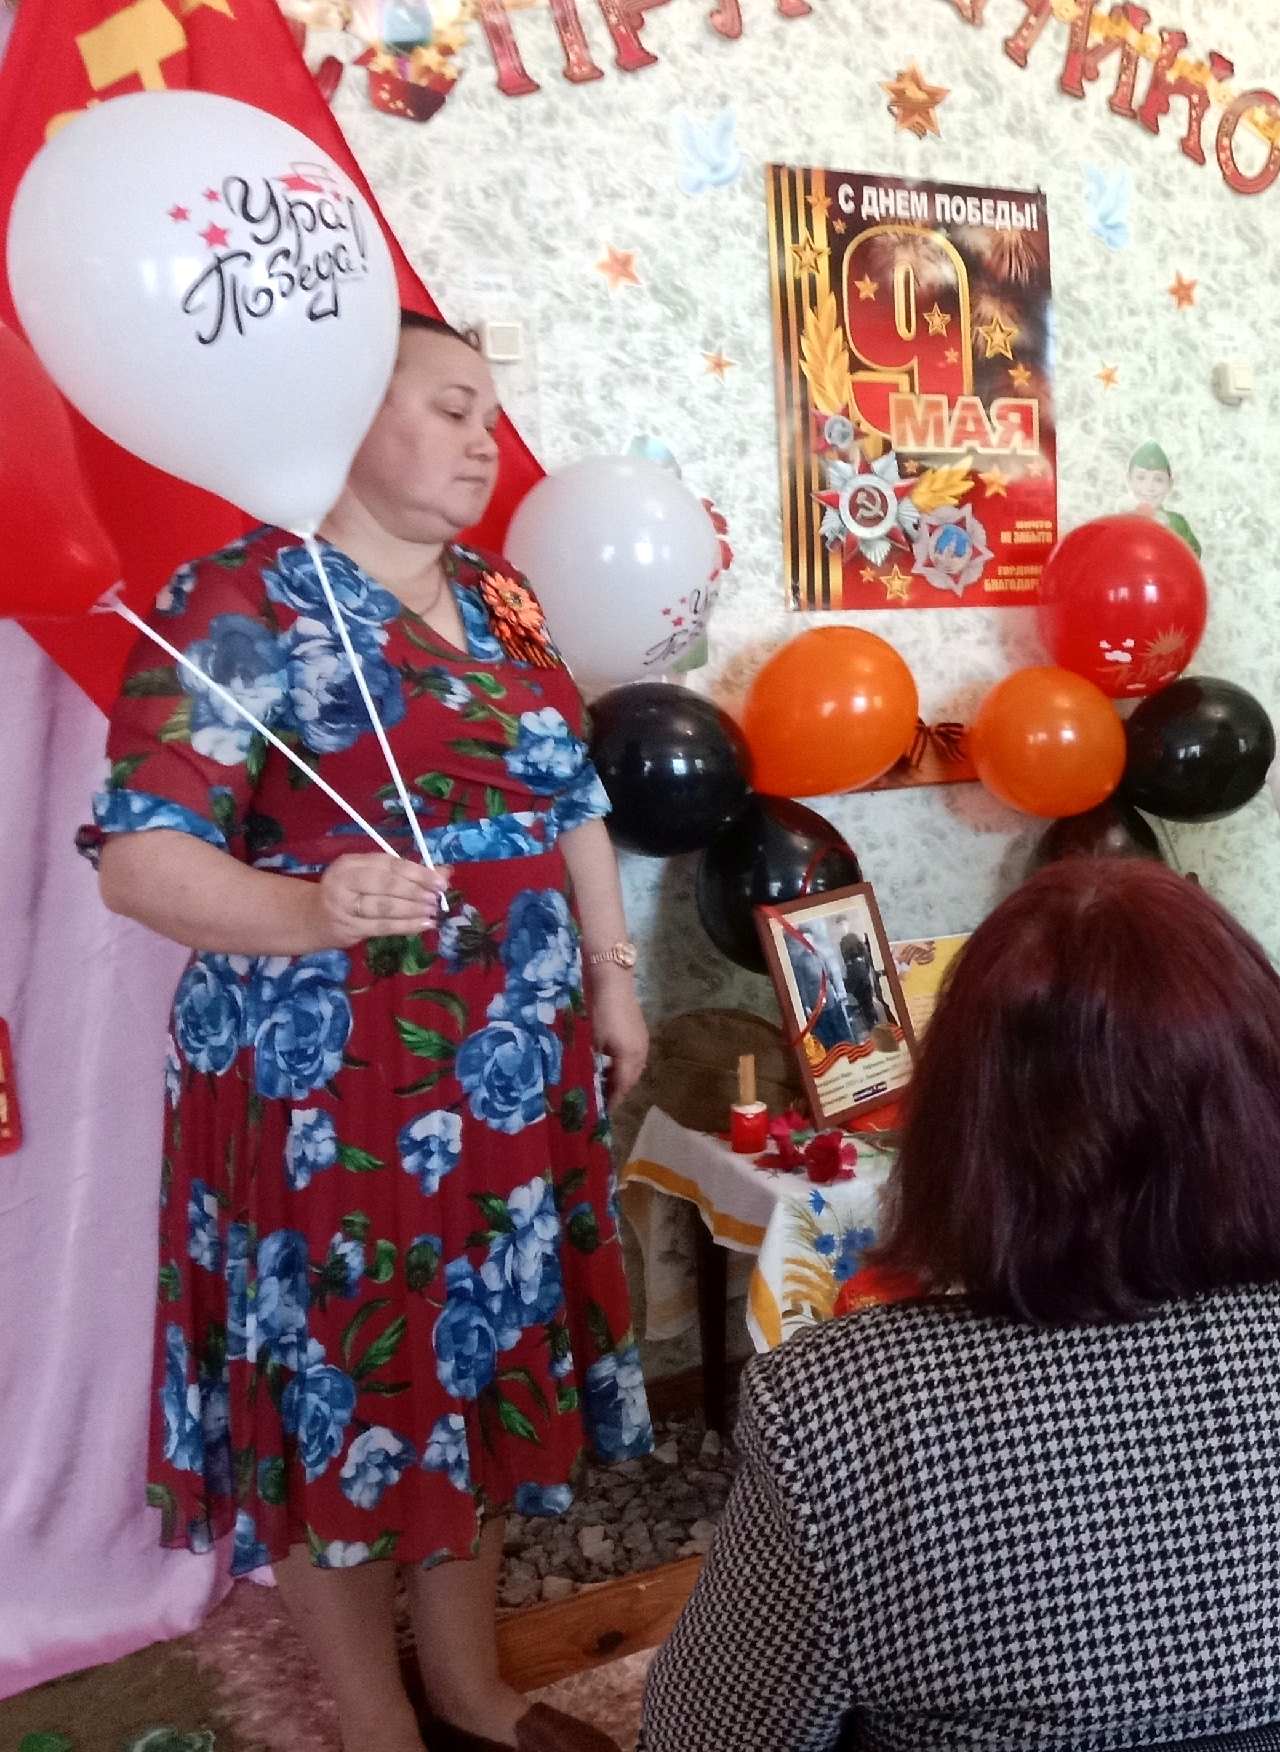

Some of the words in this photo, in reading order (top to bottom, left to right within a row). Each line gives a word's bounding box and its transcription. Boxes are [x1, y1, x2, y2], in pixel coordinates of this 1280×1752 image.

[838, 183, 856, 214] С
[861, 185, 929, 222] ДНЕМ
[934, 193, 1039, 232] ПОБЕДЫ!
[842, 223, 974, 440] 9
[888, 392, 1040, 455] МАЯ
